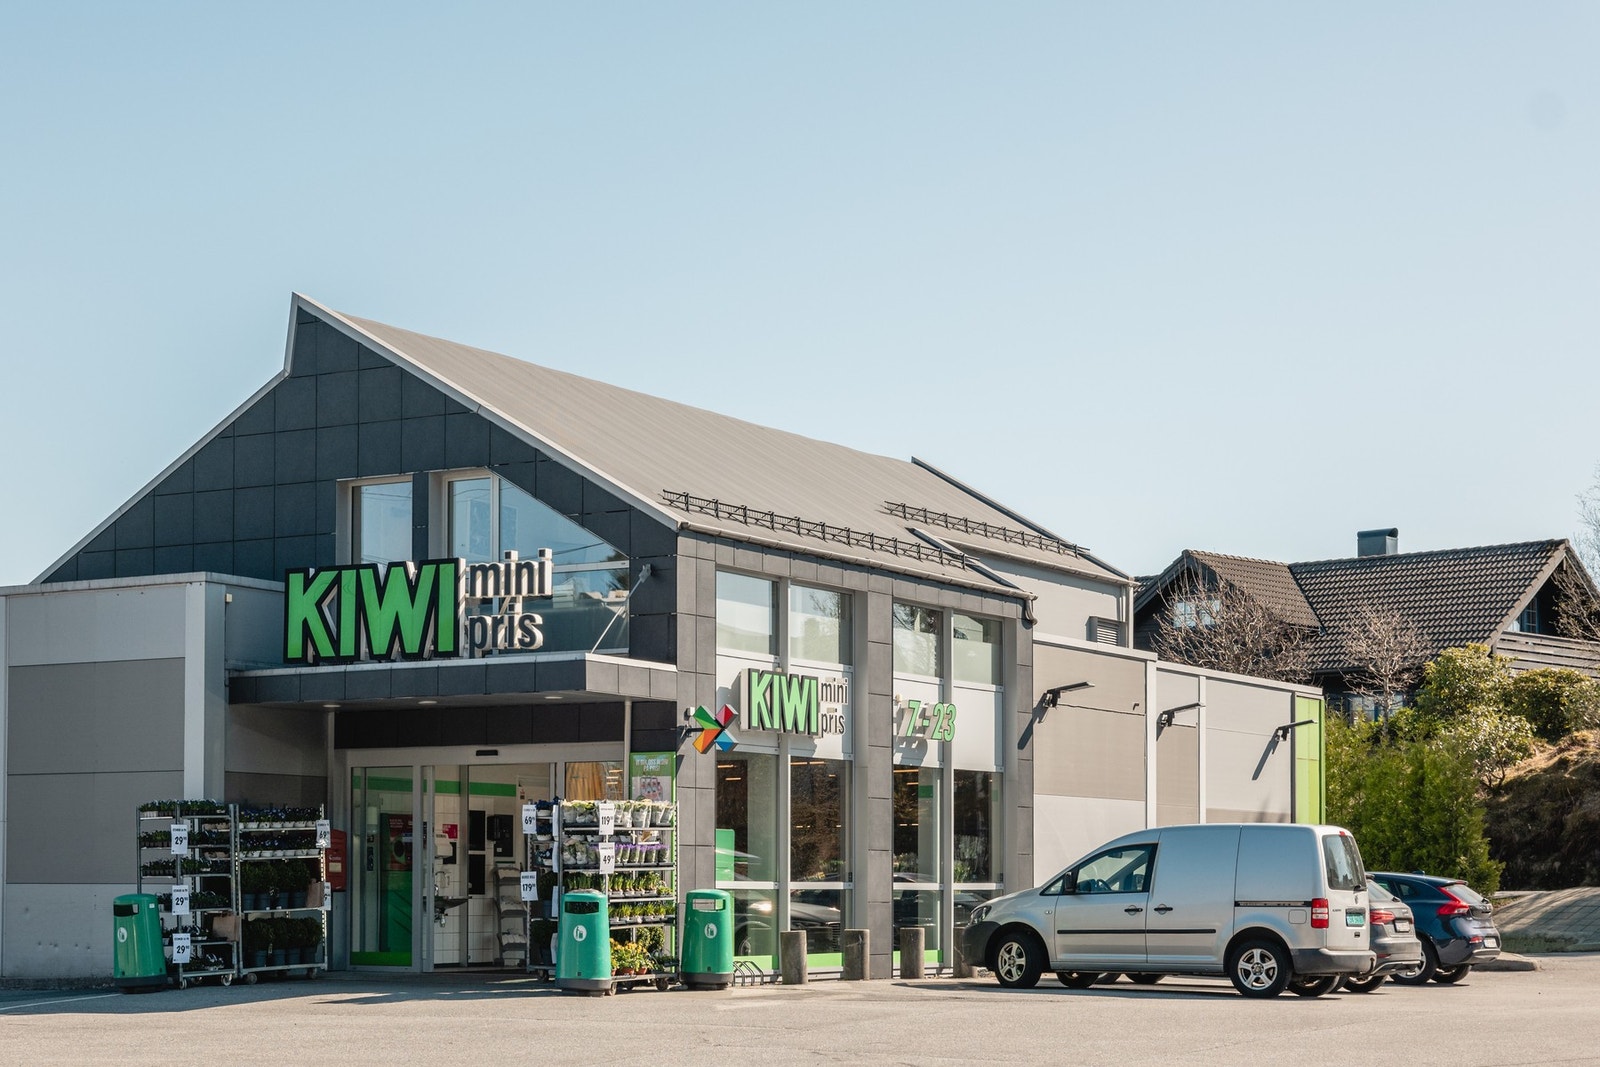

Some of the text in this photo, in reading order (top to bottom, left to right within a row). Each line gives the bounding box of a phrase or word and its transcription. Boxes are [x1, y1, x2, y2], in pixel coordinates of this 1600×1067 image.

[469, 548, 551, 597] mini
[284, 557, 462, 664] KIWI
[469, 603, 542, 658] pris
[747, 668, 819, 736] KIWI
[820, 677, 848, 704] mini
[820, 707, 846, 738] pris
[905, 699, 957, 742] 7-23
